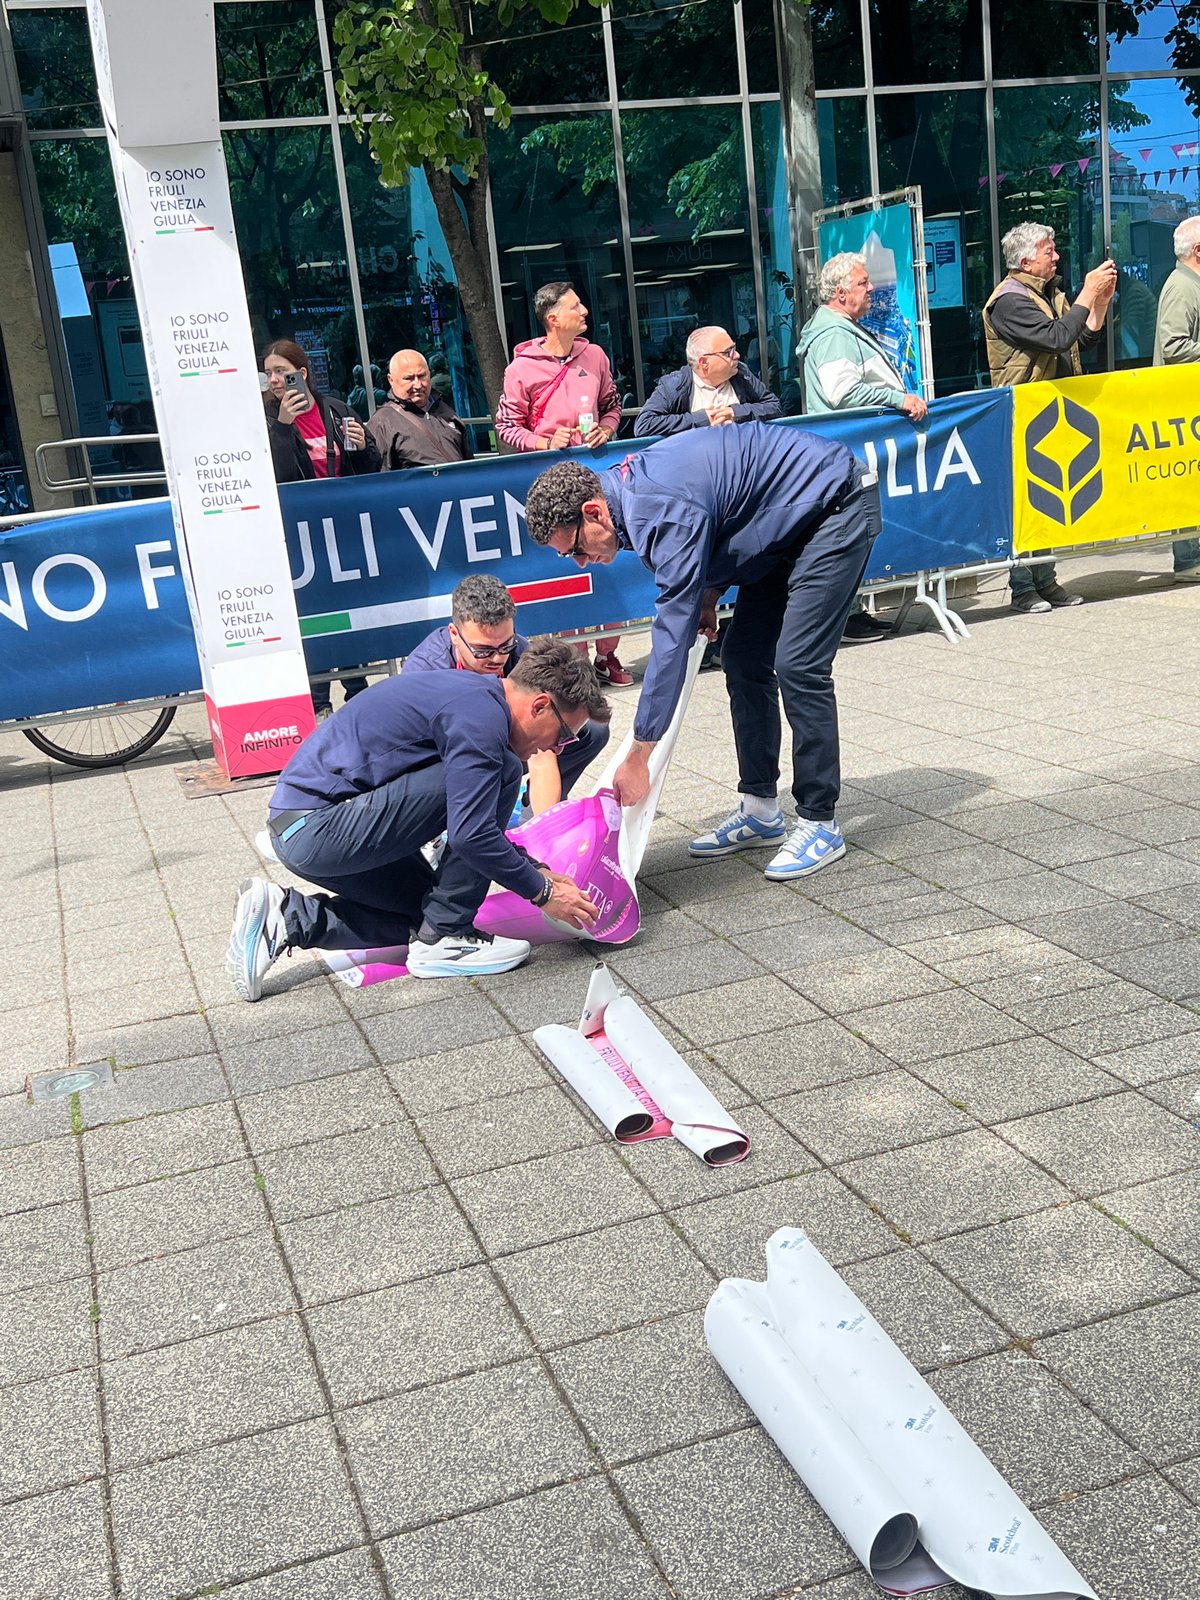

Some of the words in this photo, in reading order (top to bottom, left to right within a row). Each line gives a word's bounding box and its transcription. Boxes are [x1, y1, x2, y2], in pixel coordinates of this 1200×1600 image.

[146, 171, 161, 182] IO
[165, 168, 206, 181] SONO
[149, 184, 185, 197] FRIULI
[150, 198, 206, 212] VENEZIA
[153, 214, 197, 227] GIULIA
[170, 315, 185, 327] IO
[189, 311, 229, 325] SONO
[173, 328, 209, 341] FRIULI
[174, 341, 230, 355] VENEZIA
[177, 356, 220, 370] GIULIA
[194, 455, 209, 467] IO
[212, 450, 252, 465] SONO
[196, 466, 232, 481] FRIULI
[1128, 462, 1139, 484] Il
[198, 479, 253, 494] VENEZIA
[201, 494, 243, 508] GIULIA
[217, 590, 232, 601] IO
[235, 584, 274, 599] SONO
[219, 600, 255, 615] FRIULI
[221, 612, 274, 628] VENEZIA
[224, 626, 265, 641] GIULIA
[243, 725, 299, 744] AMORE
[240, 735, 303, 753] INFINITO
[987, 1537, 1001, 1553] 3M
